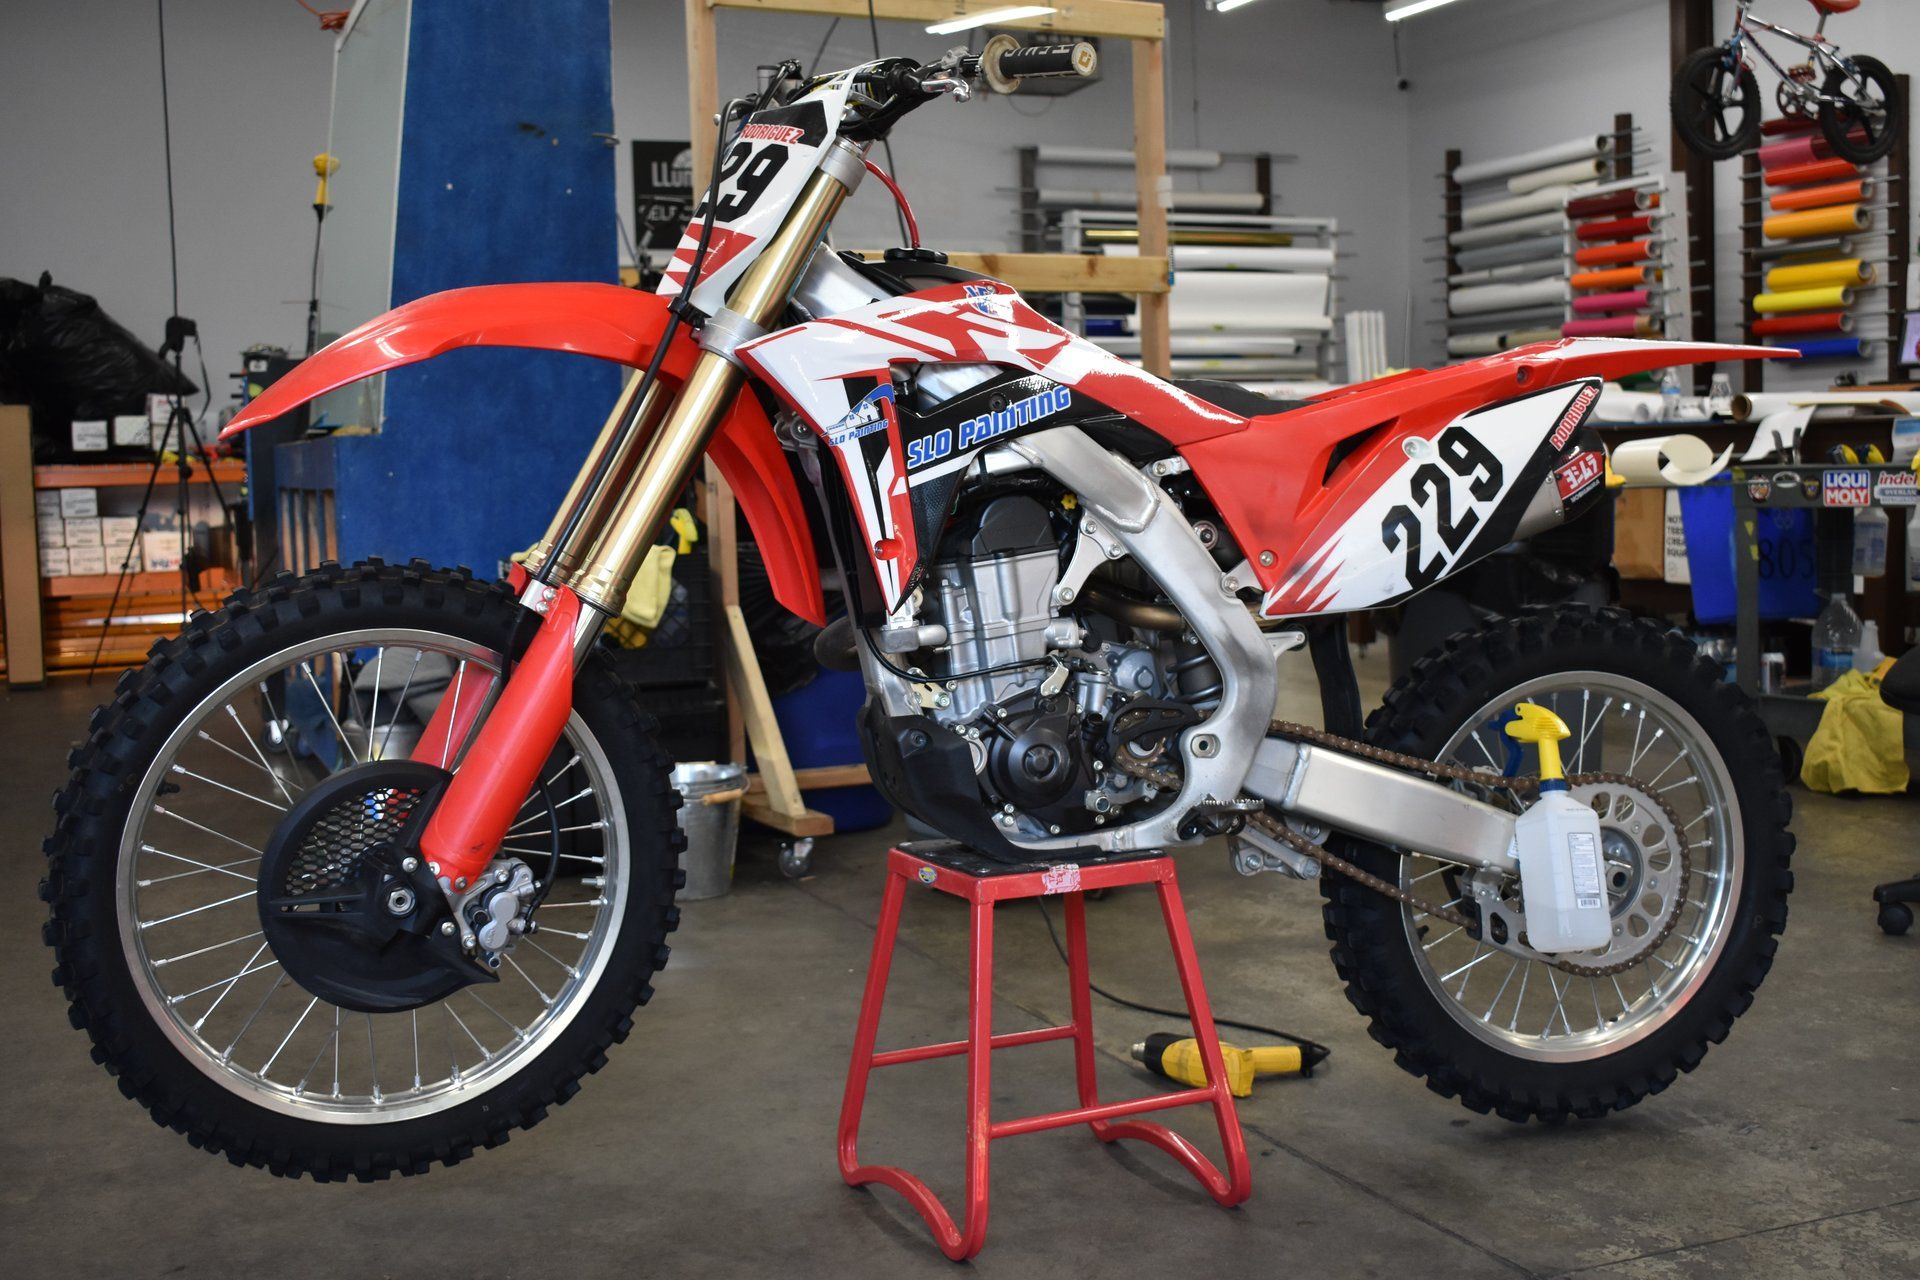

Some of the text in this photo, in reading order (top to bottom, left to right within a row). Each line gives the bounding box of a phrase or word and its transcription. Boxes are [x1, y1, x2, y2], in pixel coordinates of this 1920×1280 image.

[741, 124, 805, 144] RODRIGUEZ
[1549, 385, 1600, 452] RODRIGUEZ
[828, 434, 846, 446] SLO
[907, 429, 952, 469] SLO
[1826, 473, 1867, 487] LIQUI
[1826, 489, 1867, 504] MOLY
[1382, 427, 1503, 589] 229
